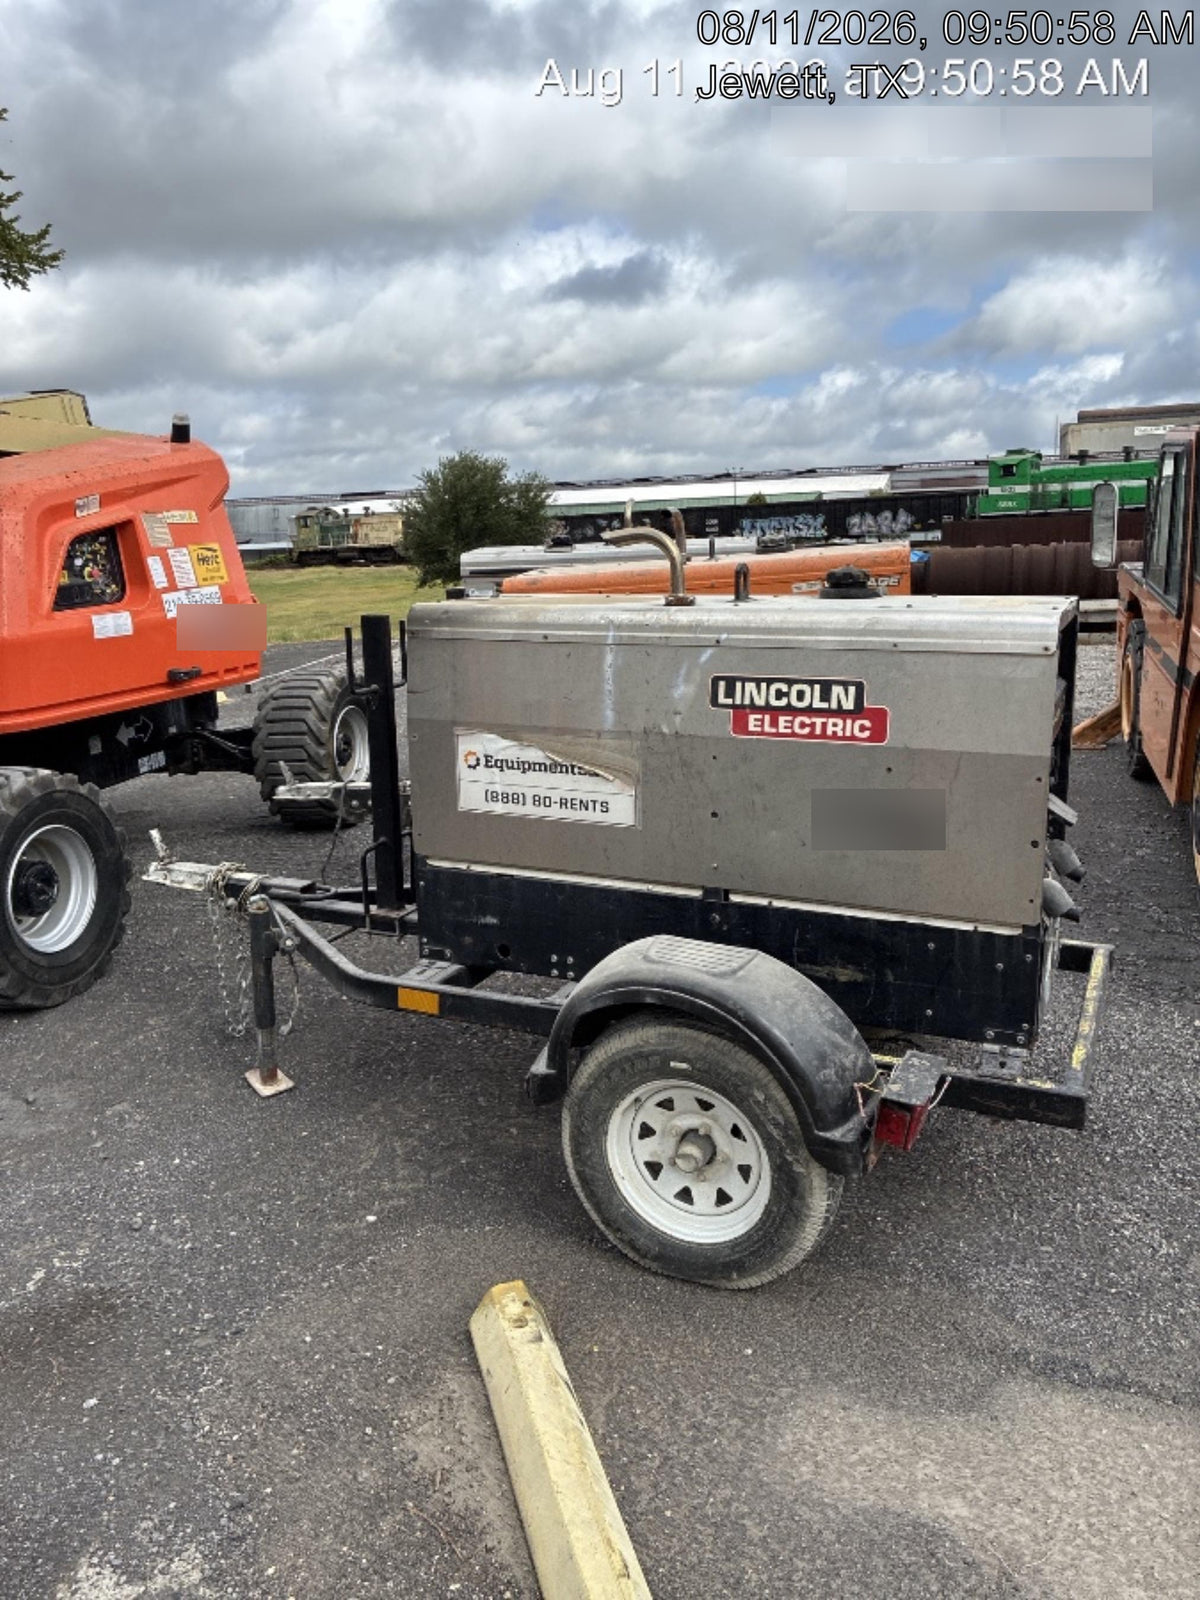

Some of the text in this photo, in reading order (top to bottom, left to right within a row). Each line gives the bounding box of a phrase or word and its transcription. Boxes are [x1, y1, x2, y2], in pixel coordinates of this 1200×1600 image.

[717, 680, 856, 710] LINCOLN
[748, 714, 872, 738] ELECTRIC
[484, 789, 610, 813] (888) 80-RENTS
